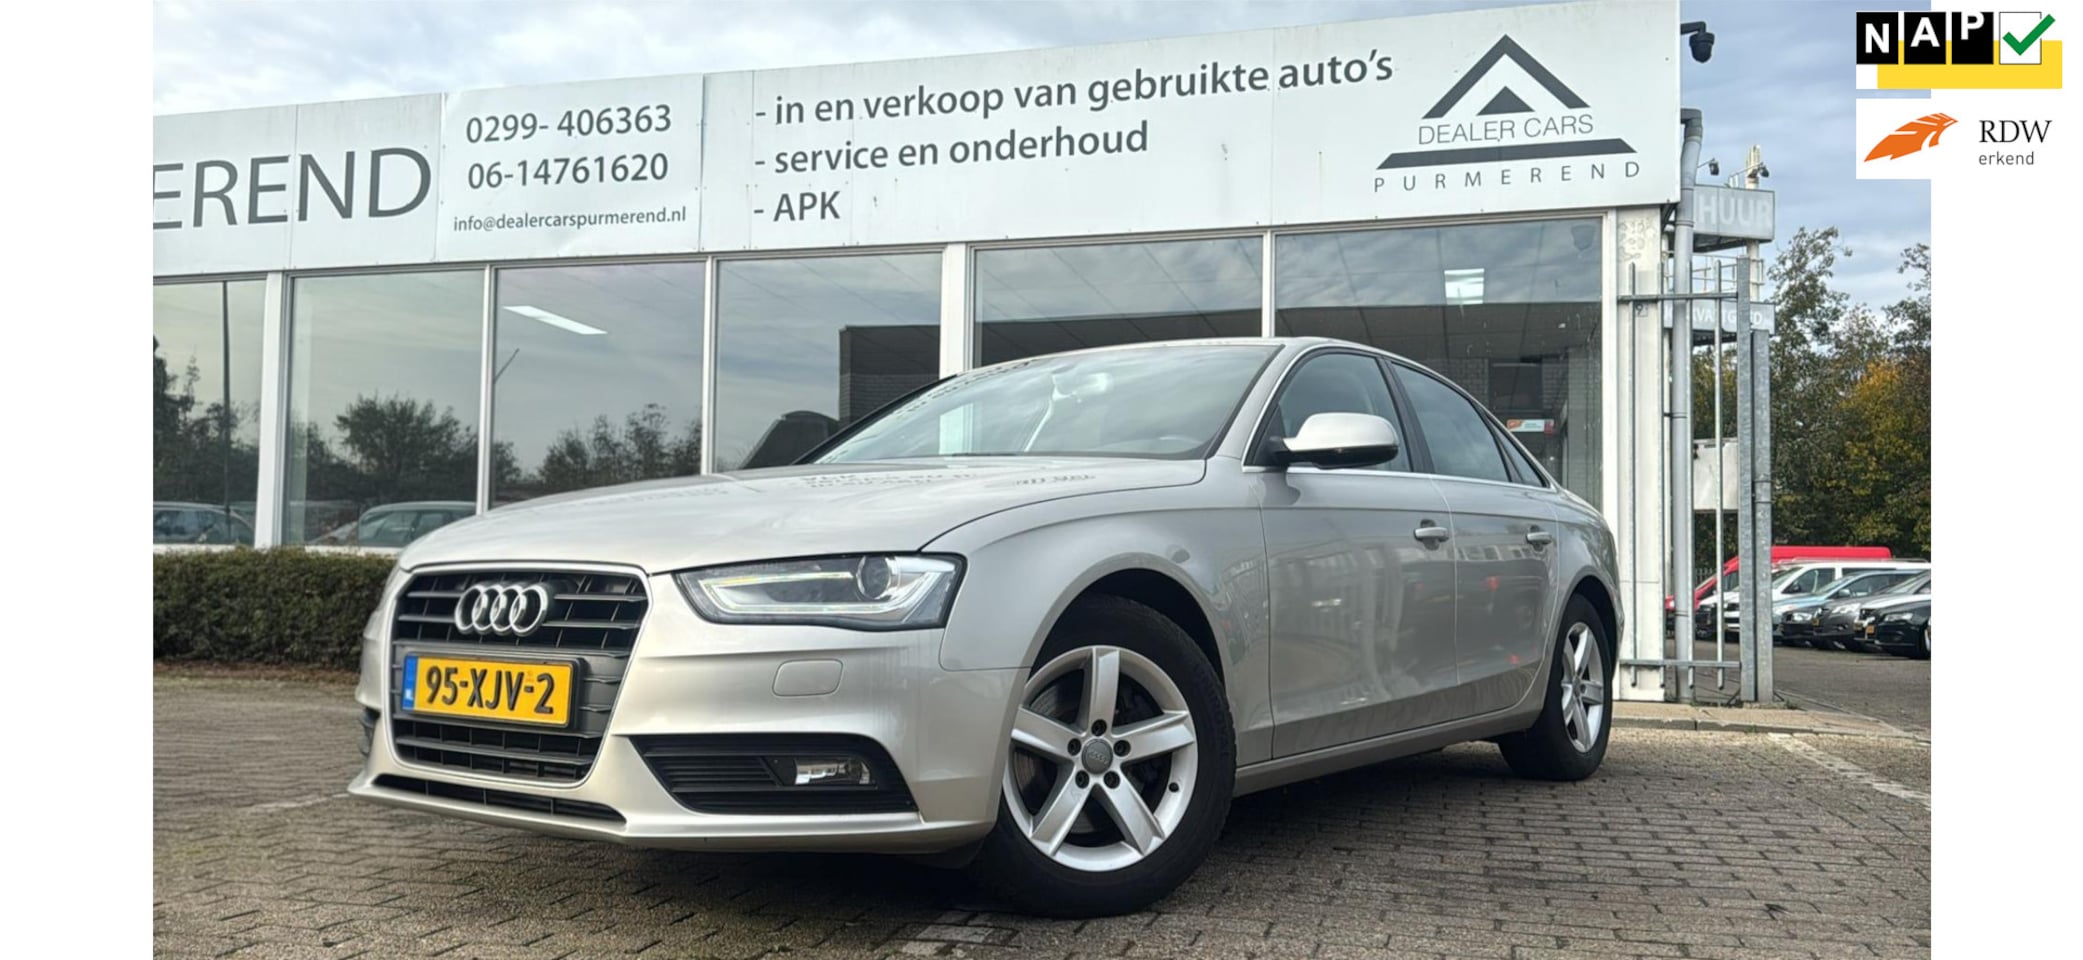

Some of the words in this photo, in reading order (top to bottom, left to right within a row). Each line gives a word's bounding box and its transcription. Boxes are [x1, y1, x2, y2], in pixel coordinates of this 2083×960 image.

[775, 95, 804, 125] in
[814, 98, 854, 122] en
[863, 85, 1004, 120] verkoop
[1014, 82, 1076, 108] van
[1088, 61, 1269, 112] gebruikte
[1278, 48, 1393, 89] auto’s
[466, 113, 549, 143] 0299-
[557, 104, 671, 137] 406363
[1418, 119, 1516, 145] DEALER
[1523, 113, 1594, 138] CARS
[775, 140, 889, 174] service
[898, 143, 938, 167] en
[949, 119, 1148, 164] onderhoud
[154, 148, 431, 230] EREND
[468, 152, 668, 190] 06-14761620
[1374, 161, 1640, 193] PURMEREND
[453, 206, 687, 232] info@dealercarspurmerend.nl
[773, 190, 840, 222] APK
[1699, 194, 1772, 227] HUUR
[425, 665, 555, 715] 95-XJV-2
